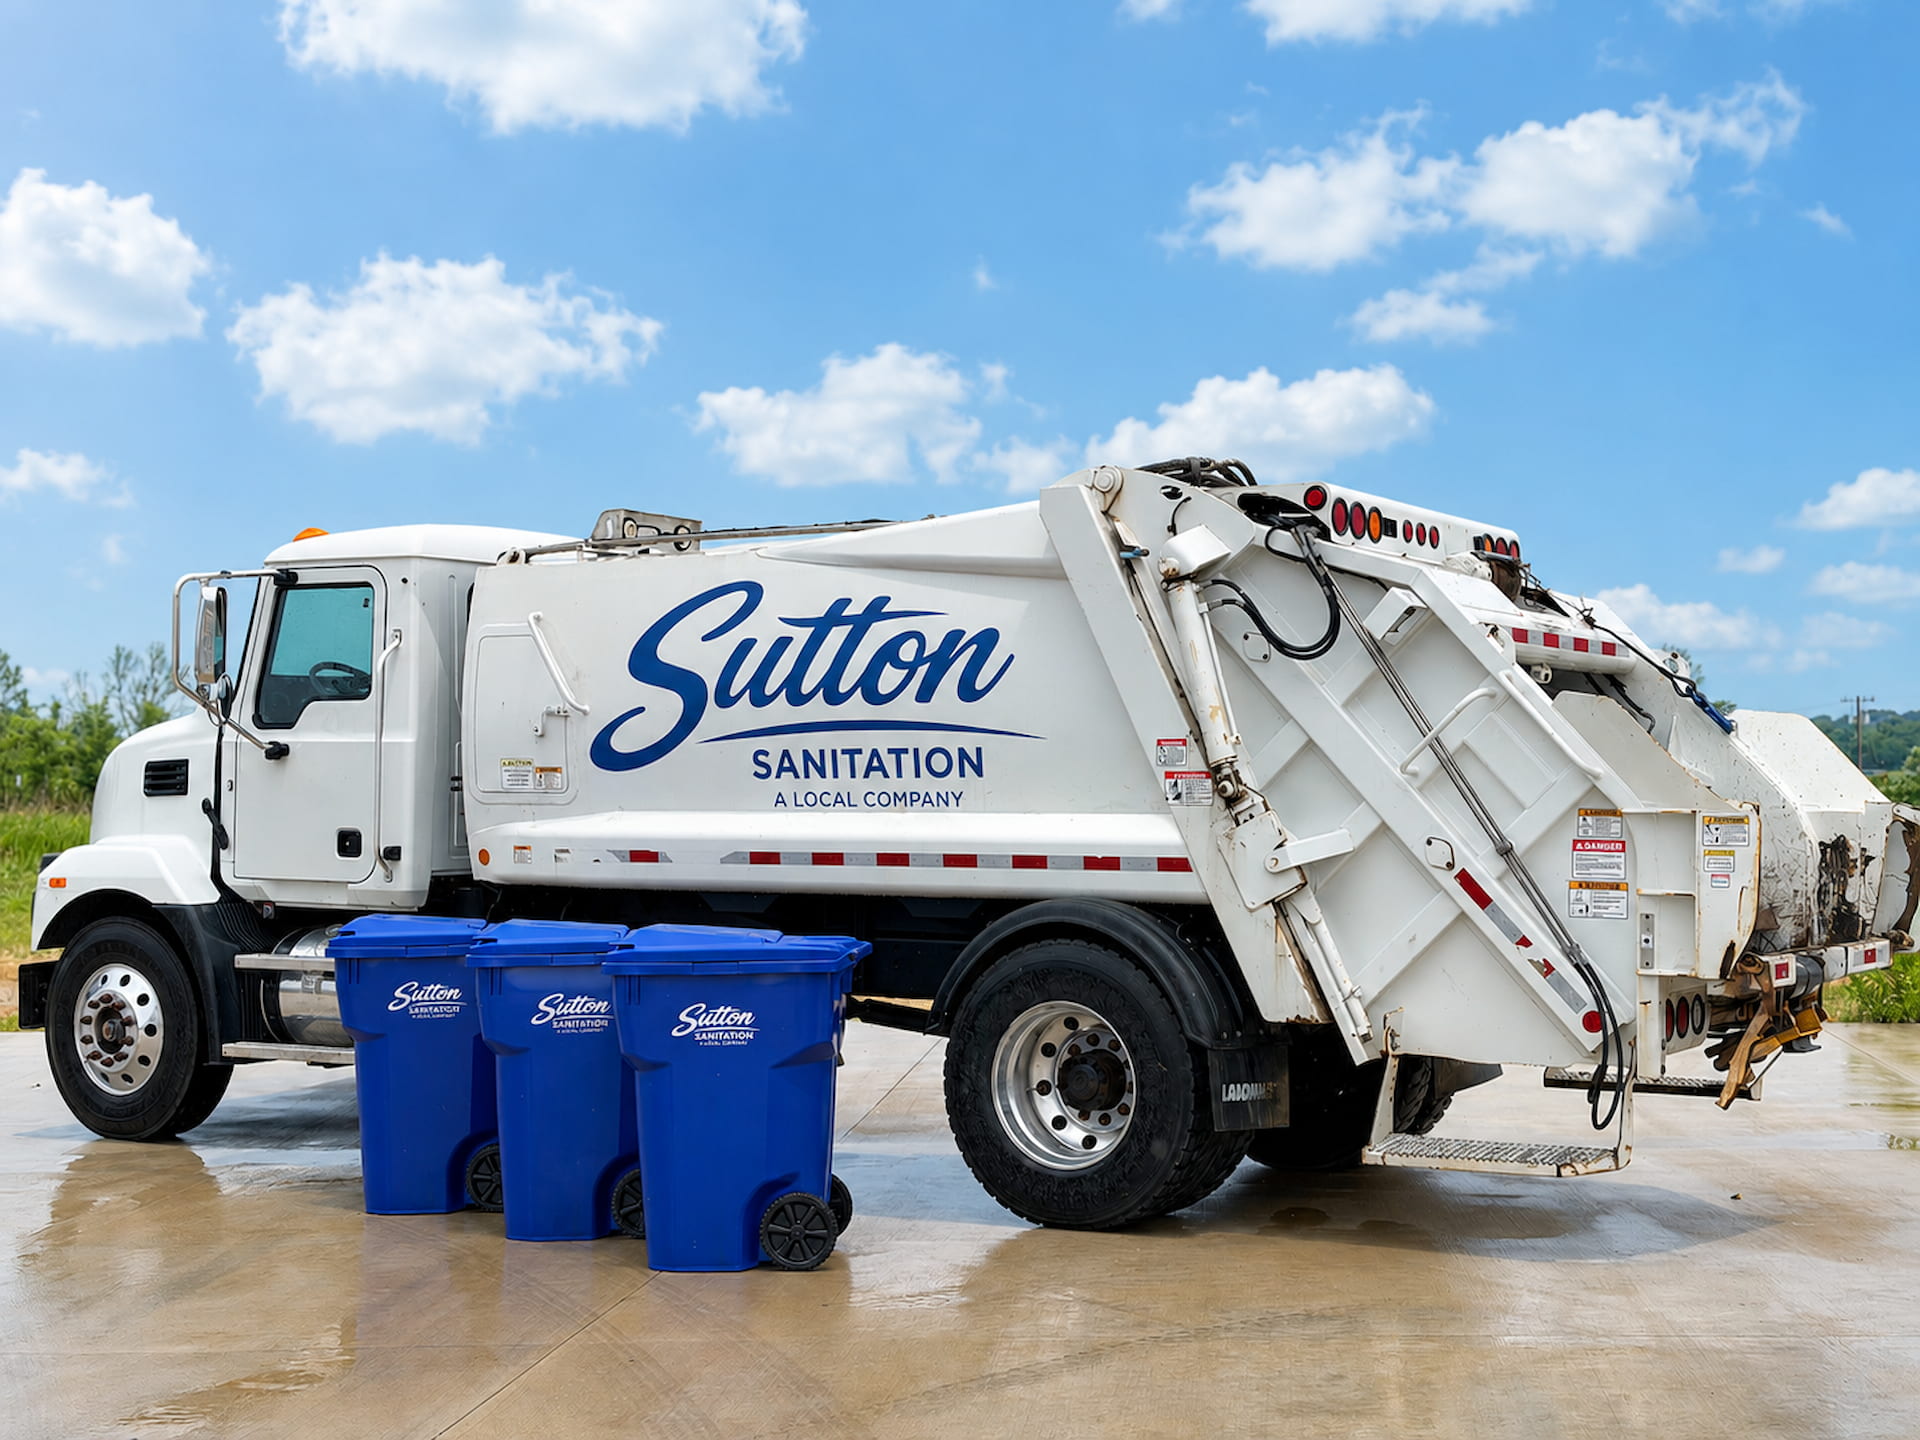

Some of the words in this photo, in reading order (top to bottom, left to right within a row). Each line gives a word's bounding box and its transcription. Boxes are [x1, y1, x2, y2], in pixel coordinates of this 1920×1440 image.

[590, 580, 1015, 771] Sutton
[752, 746, 984, 780] SANITATION
[774, 791, 788, 808] A
[793, 791, 858, 808] LOCAL
[863, 790, 964, 808] COMPANY
[387, 981, 462, 1011] Sutton
[530, 993, 612, 1025] Sutton
[671, 1003, 756, 1037] Sutton
